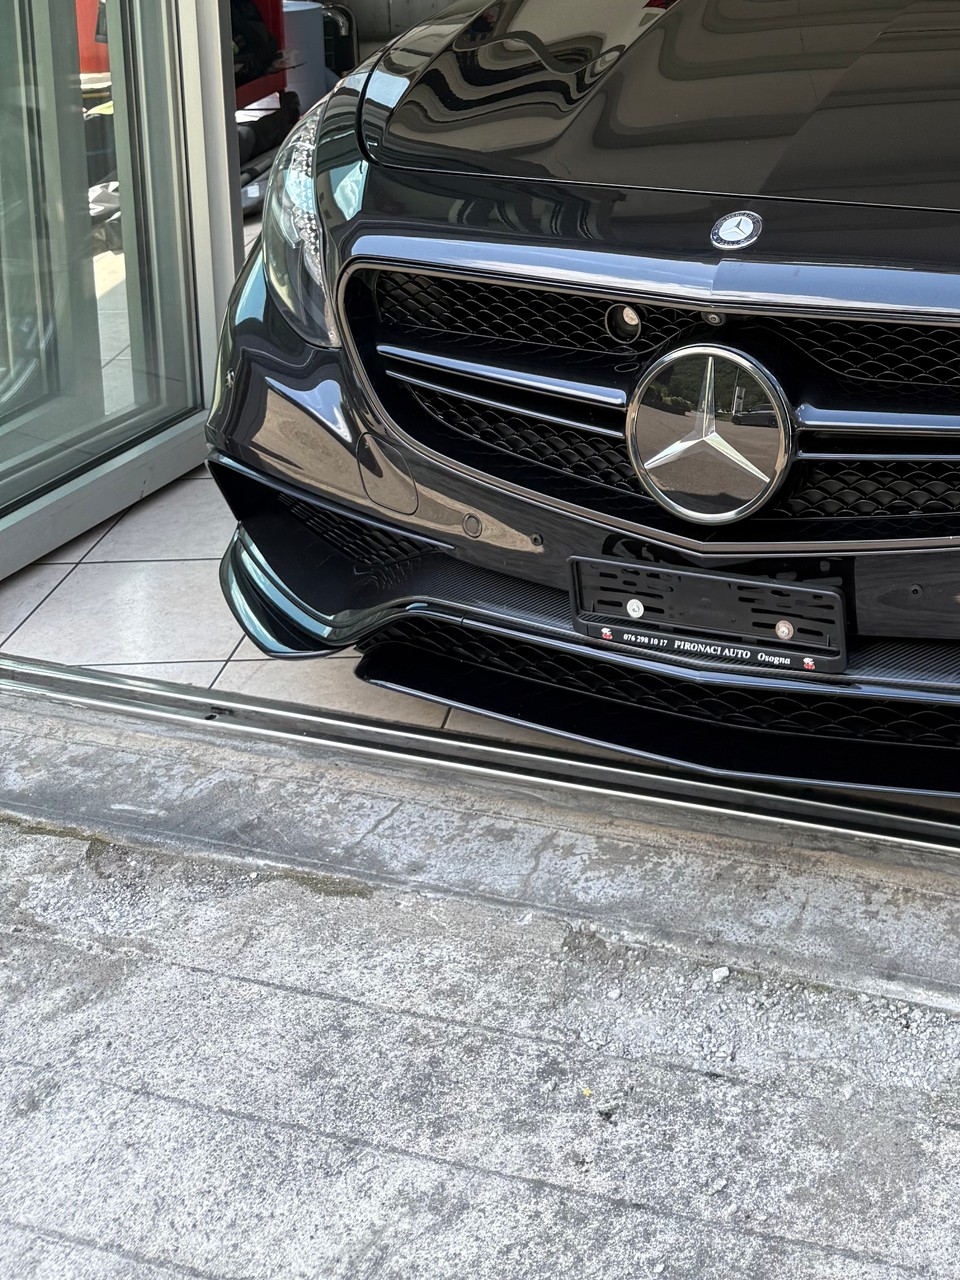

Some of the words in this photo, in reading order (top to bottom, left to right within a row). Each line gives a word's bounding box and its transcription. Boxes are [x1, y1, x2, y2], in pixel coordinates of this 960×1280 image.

[623, 633, 636, 642] 076
[636, 635, 649, 644] 298
[650, 637, 659, 645] 10
[660, 639, 668, 647] 17
[674, 640, 721, 655] PIRONACI
[722, 647, 751, 659] AUTO
[757, 652, 791, 665] Osogna
